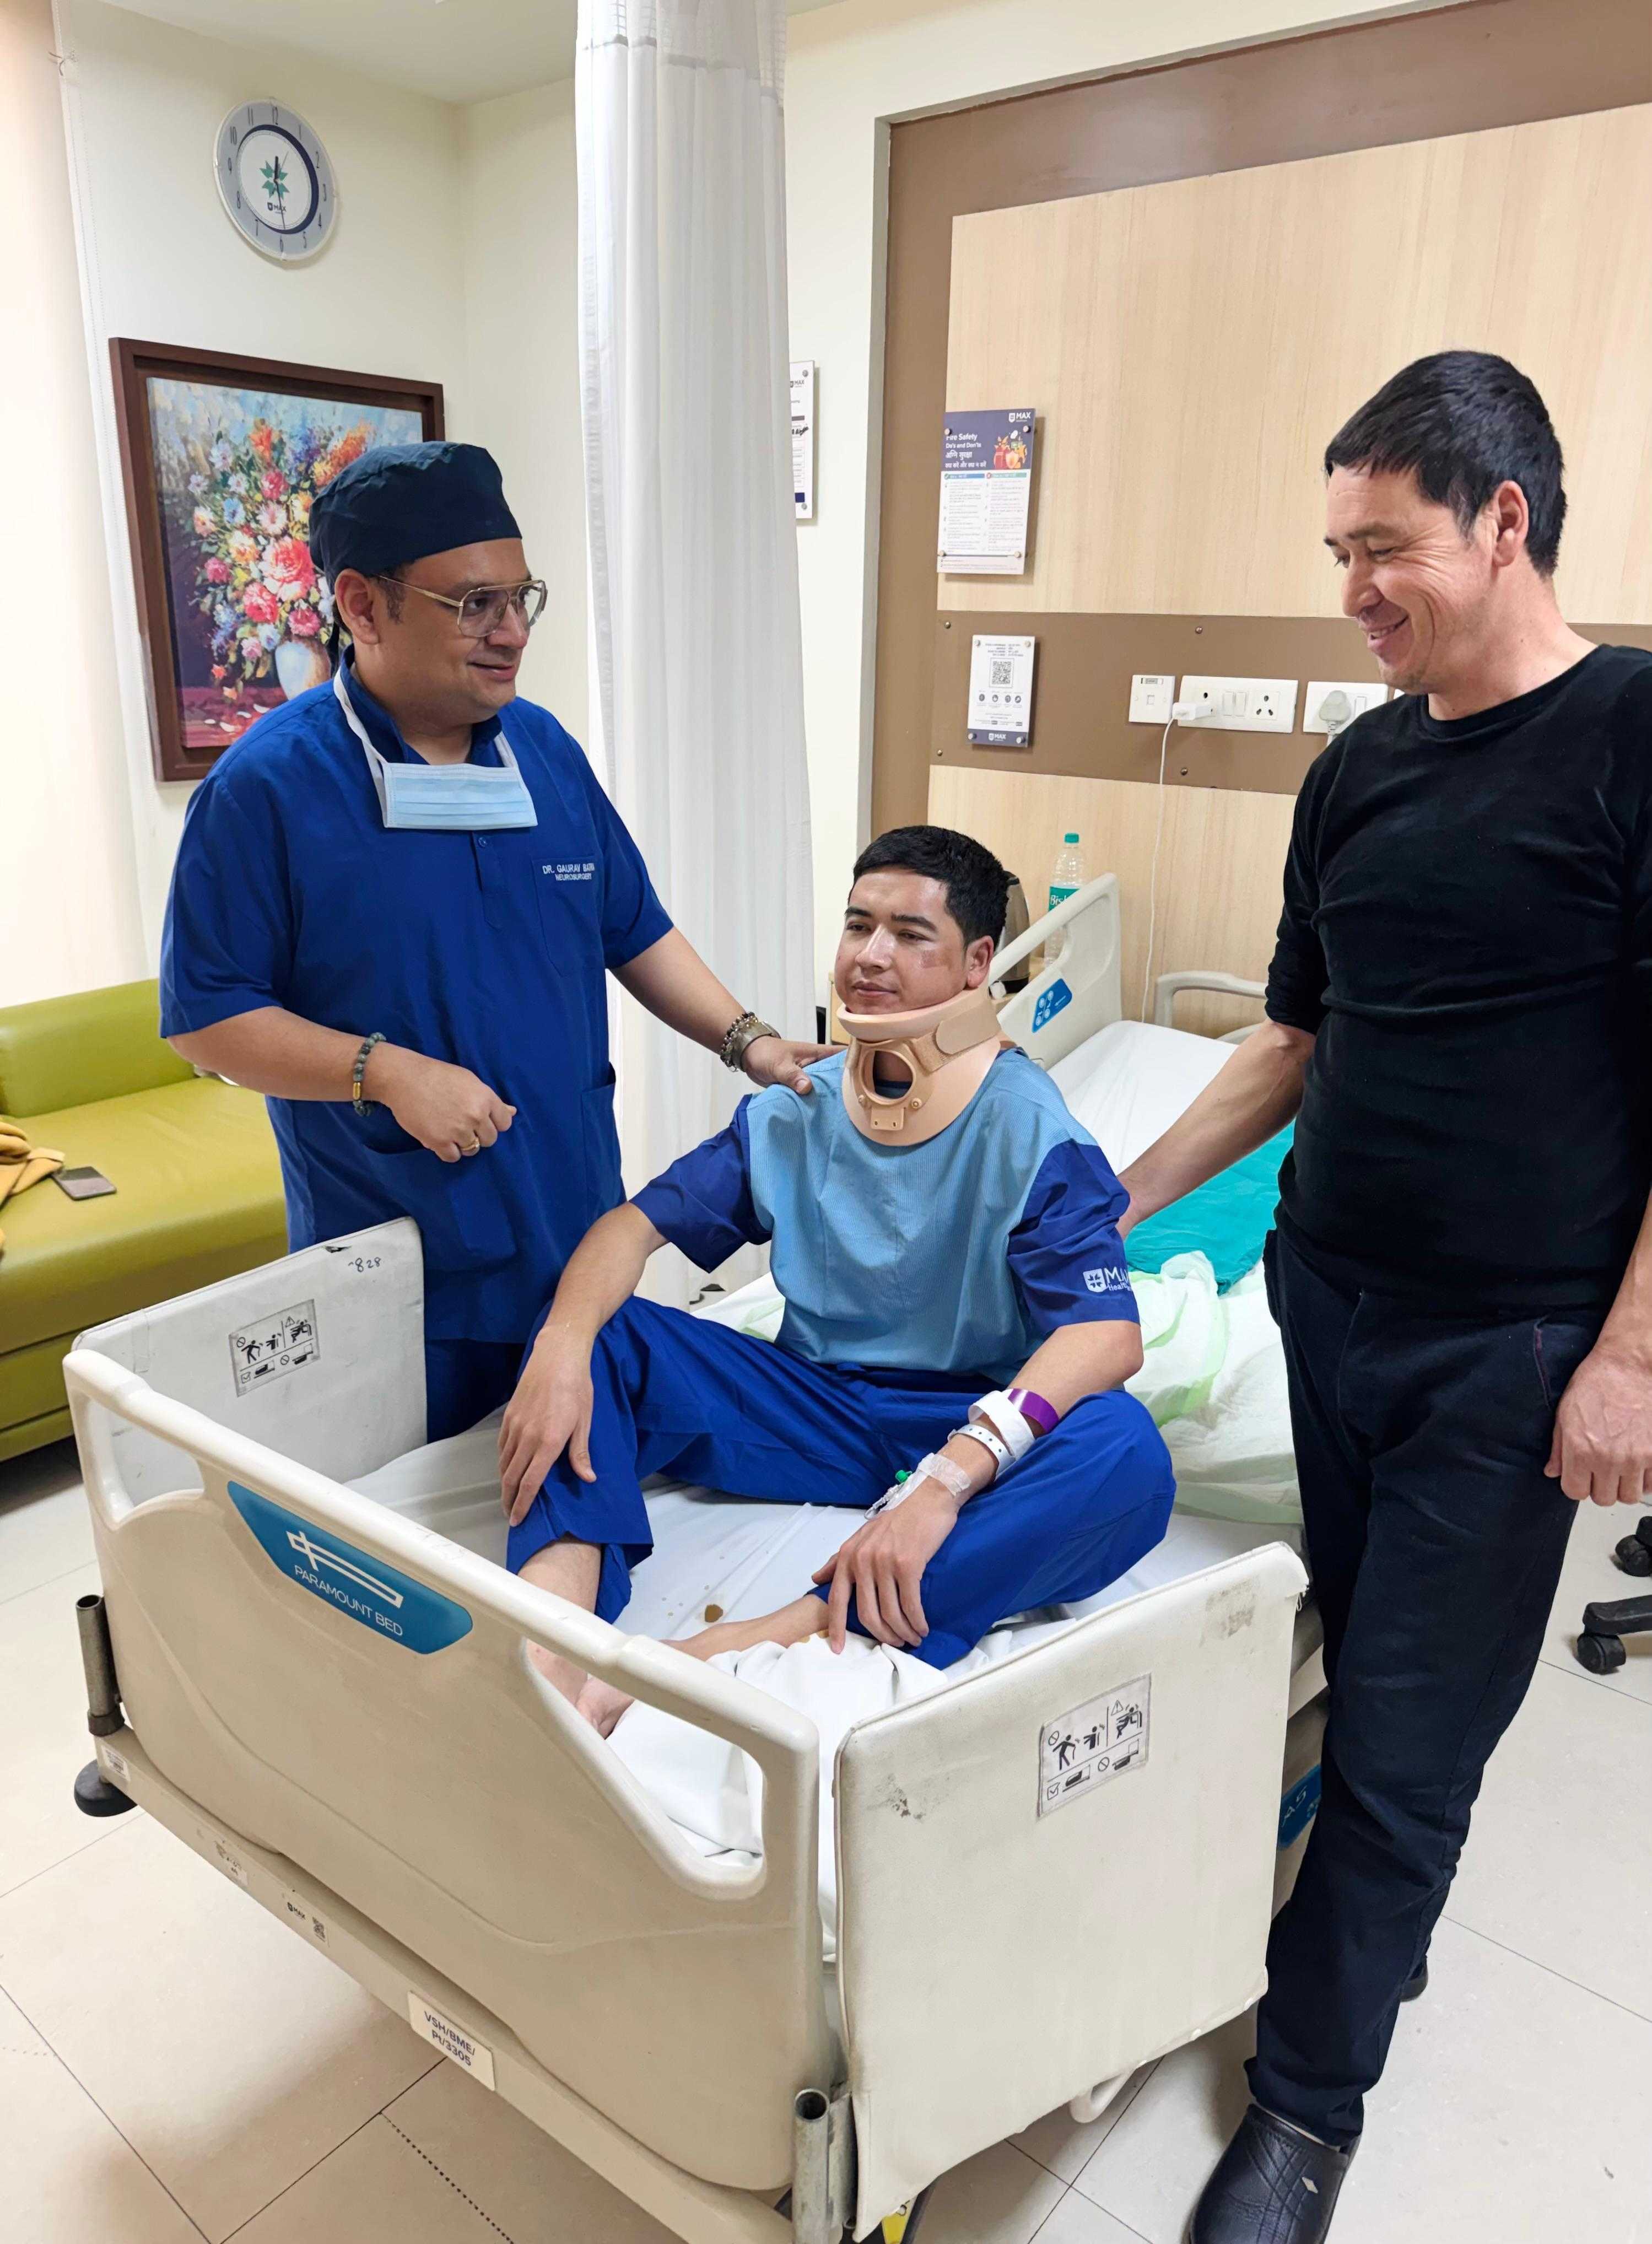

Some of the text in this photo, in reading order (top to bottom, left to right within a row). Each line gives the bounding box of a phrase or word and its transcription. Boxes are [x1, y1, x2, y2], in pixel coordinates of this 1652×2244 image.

[247, 106, 253, 126] 11
[272, 106, 278, 125] 12
[230, 126, 237, 145] 10
[228, 158, 232, 175] 9
[316, 151, 319, 168] 2
[236, 191, 241, 209] 8
[322, 184, 326, 202] 3
[542, 865, 555, 874] DR.
[294, 1565, 403, 1636] PARAMOUNT BED
